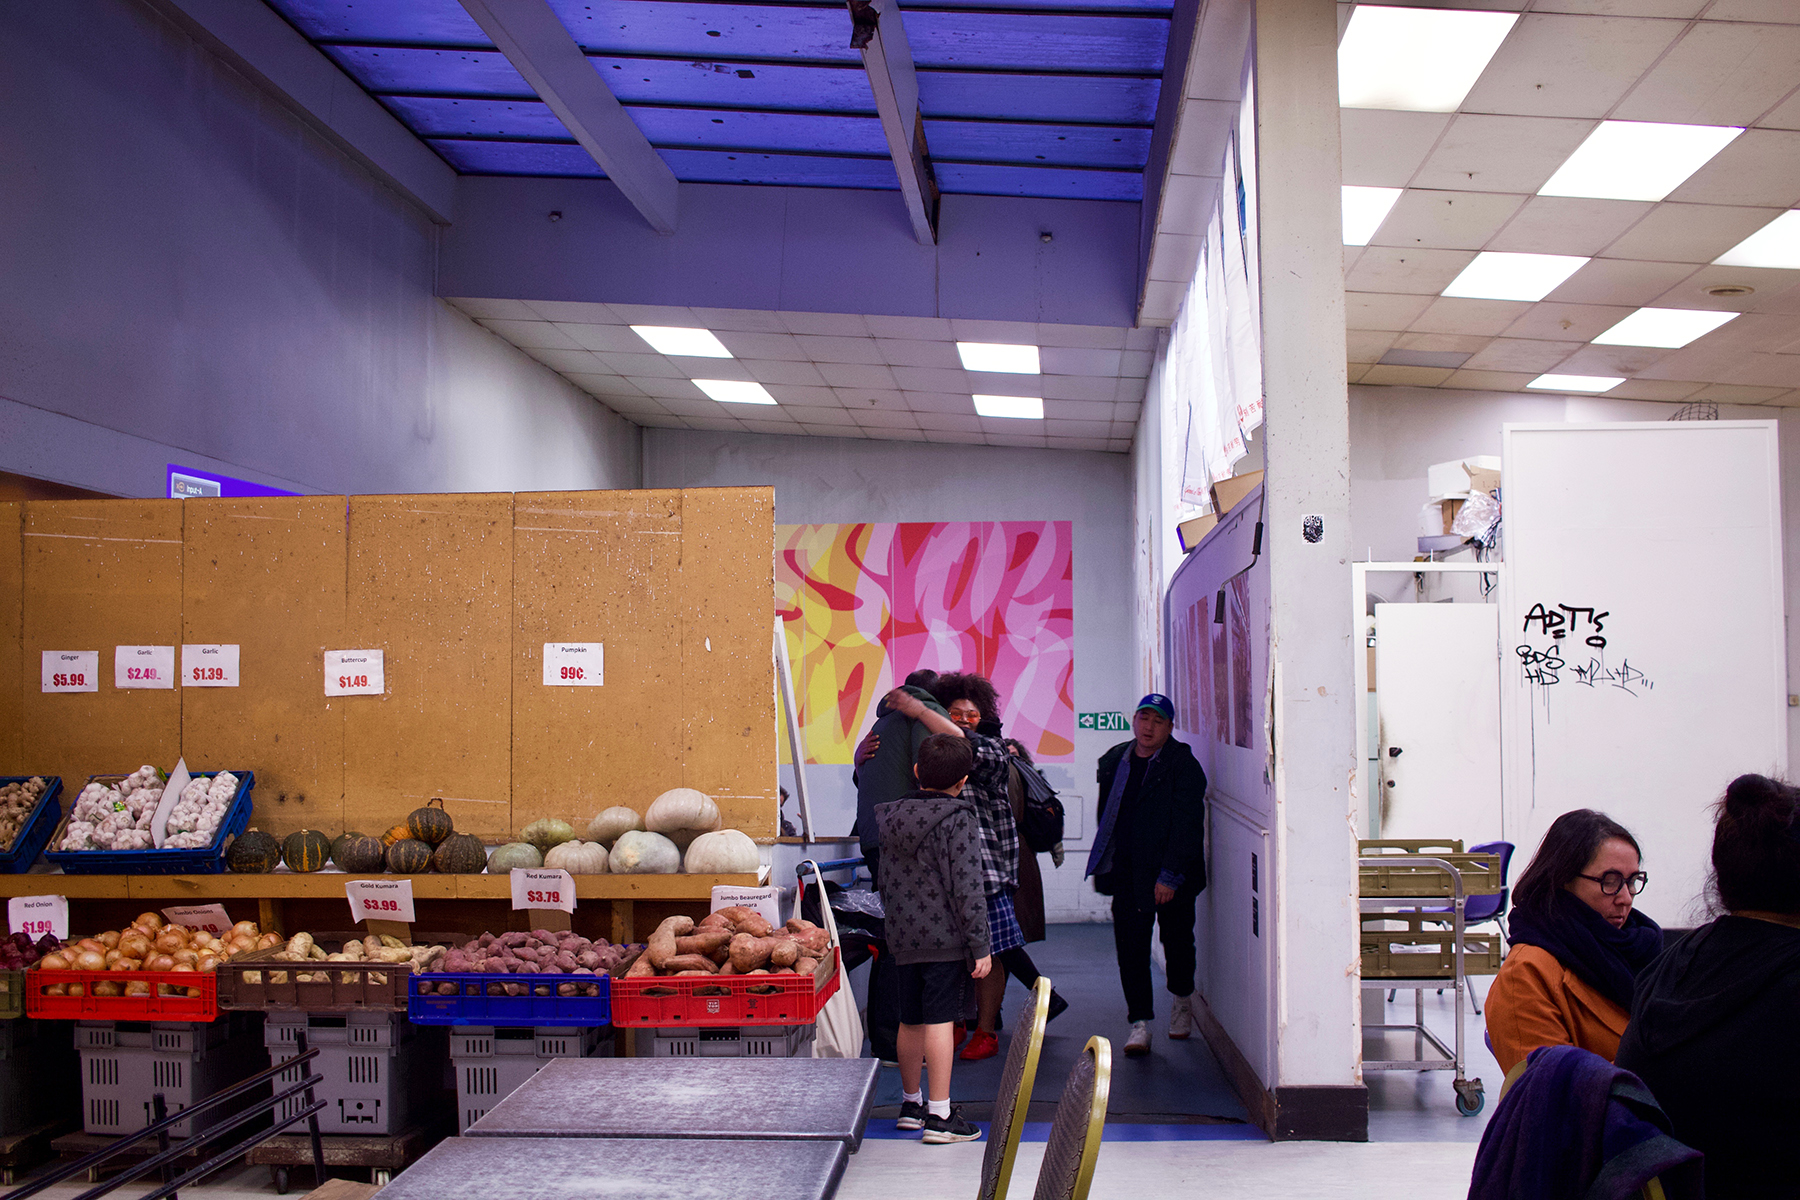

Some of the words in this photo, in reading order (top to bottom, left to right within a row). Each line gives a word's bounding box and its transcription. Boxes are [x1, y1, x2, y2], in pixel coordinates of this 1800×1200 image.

[61, 654, 80, 662] Ginger
[53, 673, 85, 687] $5.99
[127, 667, 157, 680] $2.49
[193, 667, 223, 681] $1.39
[339, 675, 368, 688] $1.49
[1097, 713, 1125, 729] EXIT
[526, 872, 538, 880] Red
[527, 889, 561, 903] $3.79
[740, 893, 772, 901] Beauregard
[363, 899, 399, 912] $3.99
[22, 920, 52, 934] $1.99
